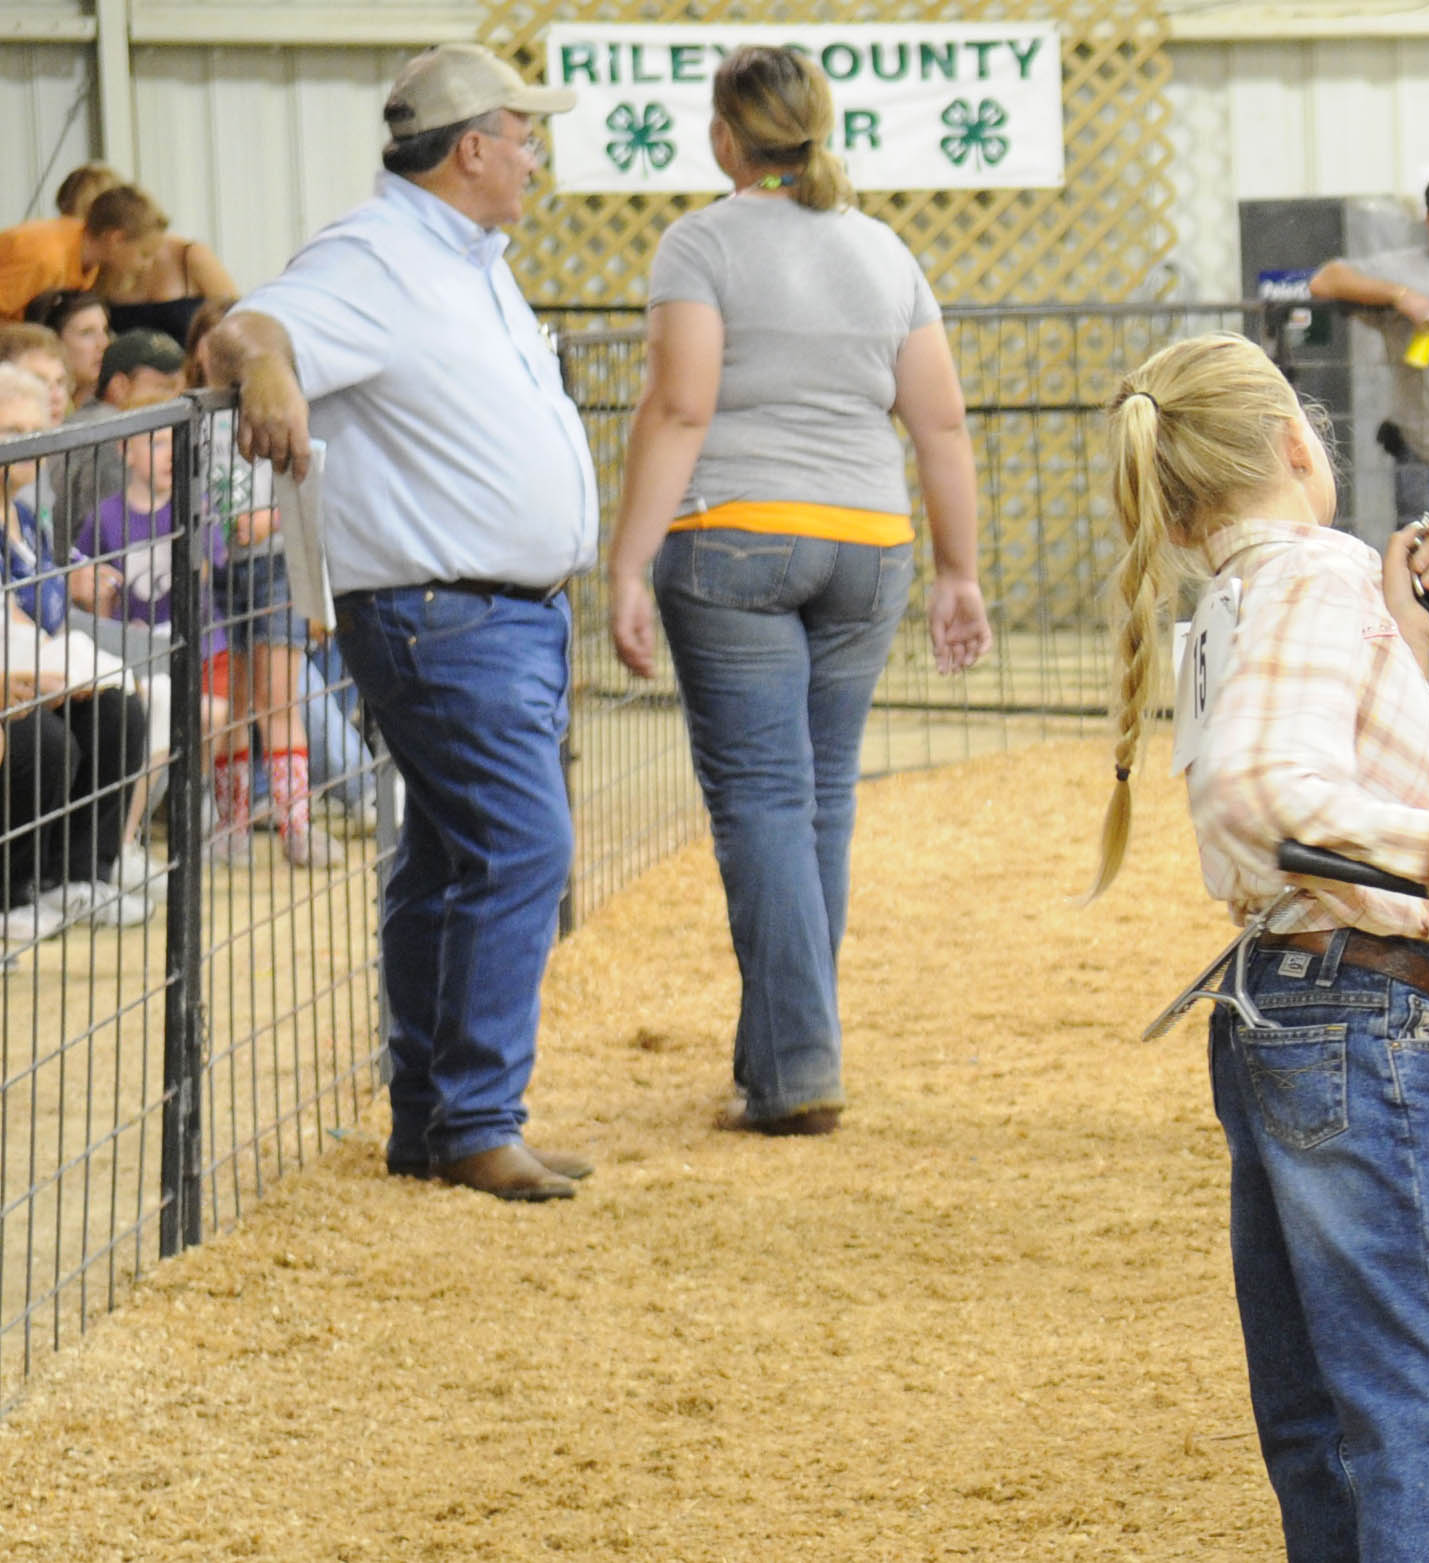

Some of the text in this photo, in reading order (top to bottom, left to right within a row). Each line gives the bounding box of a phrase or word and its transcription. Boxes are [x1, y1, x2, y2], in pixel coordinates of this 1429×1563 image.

[560, 38, 1042, 85] RILE OUNTY
[1194, 630, 1207, 718] 15
